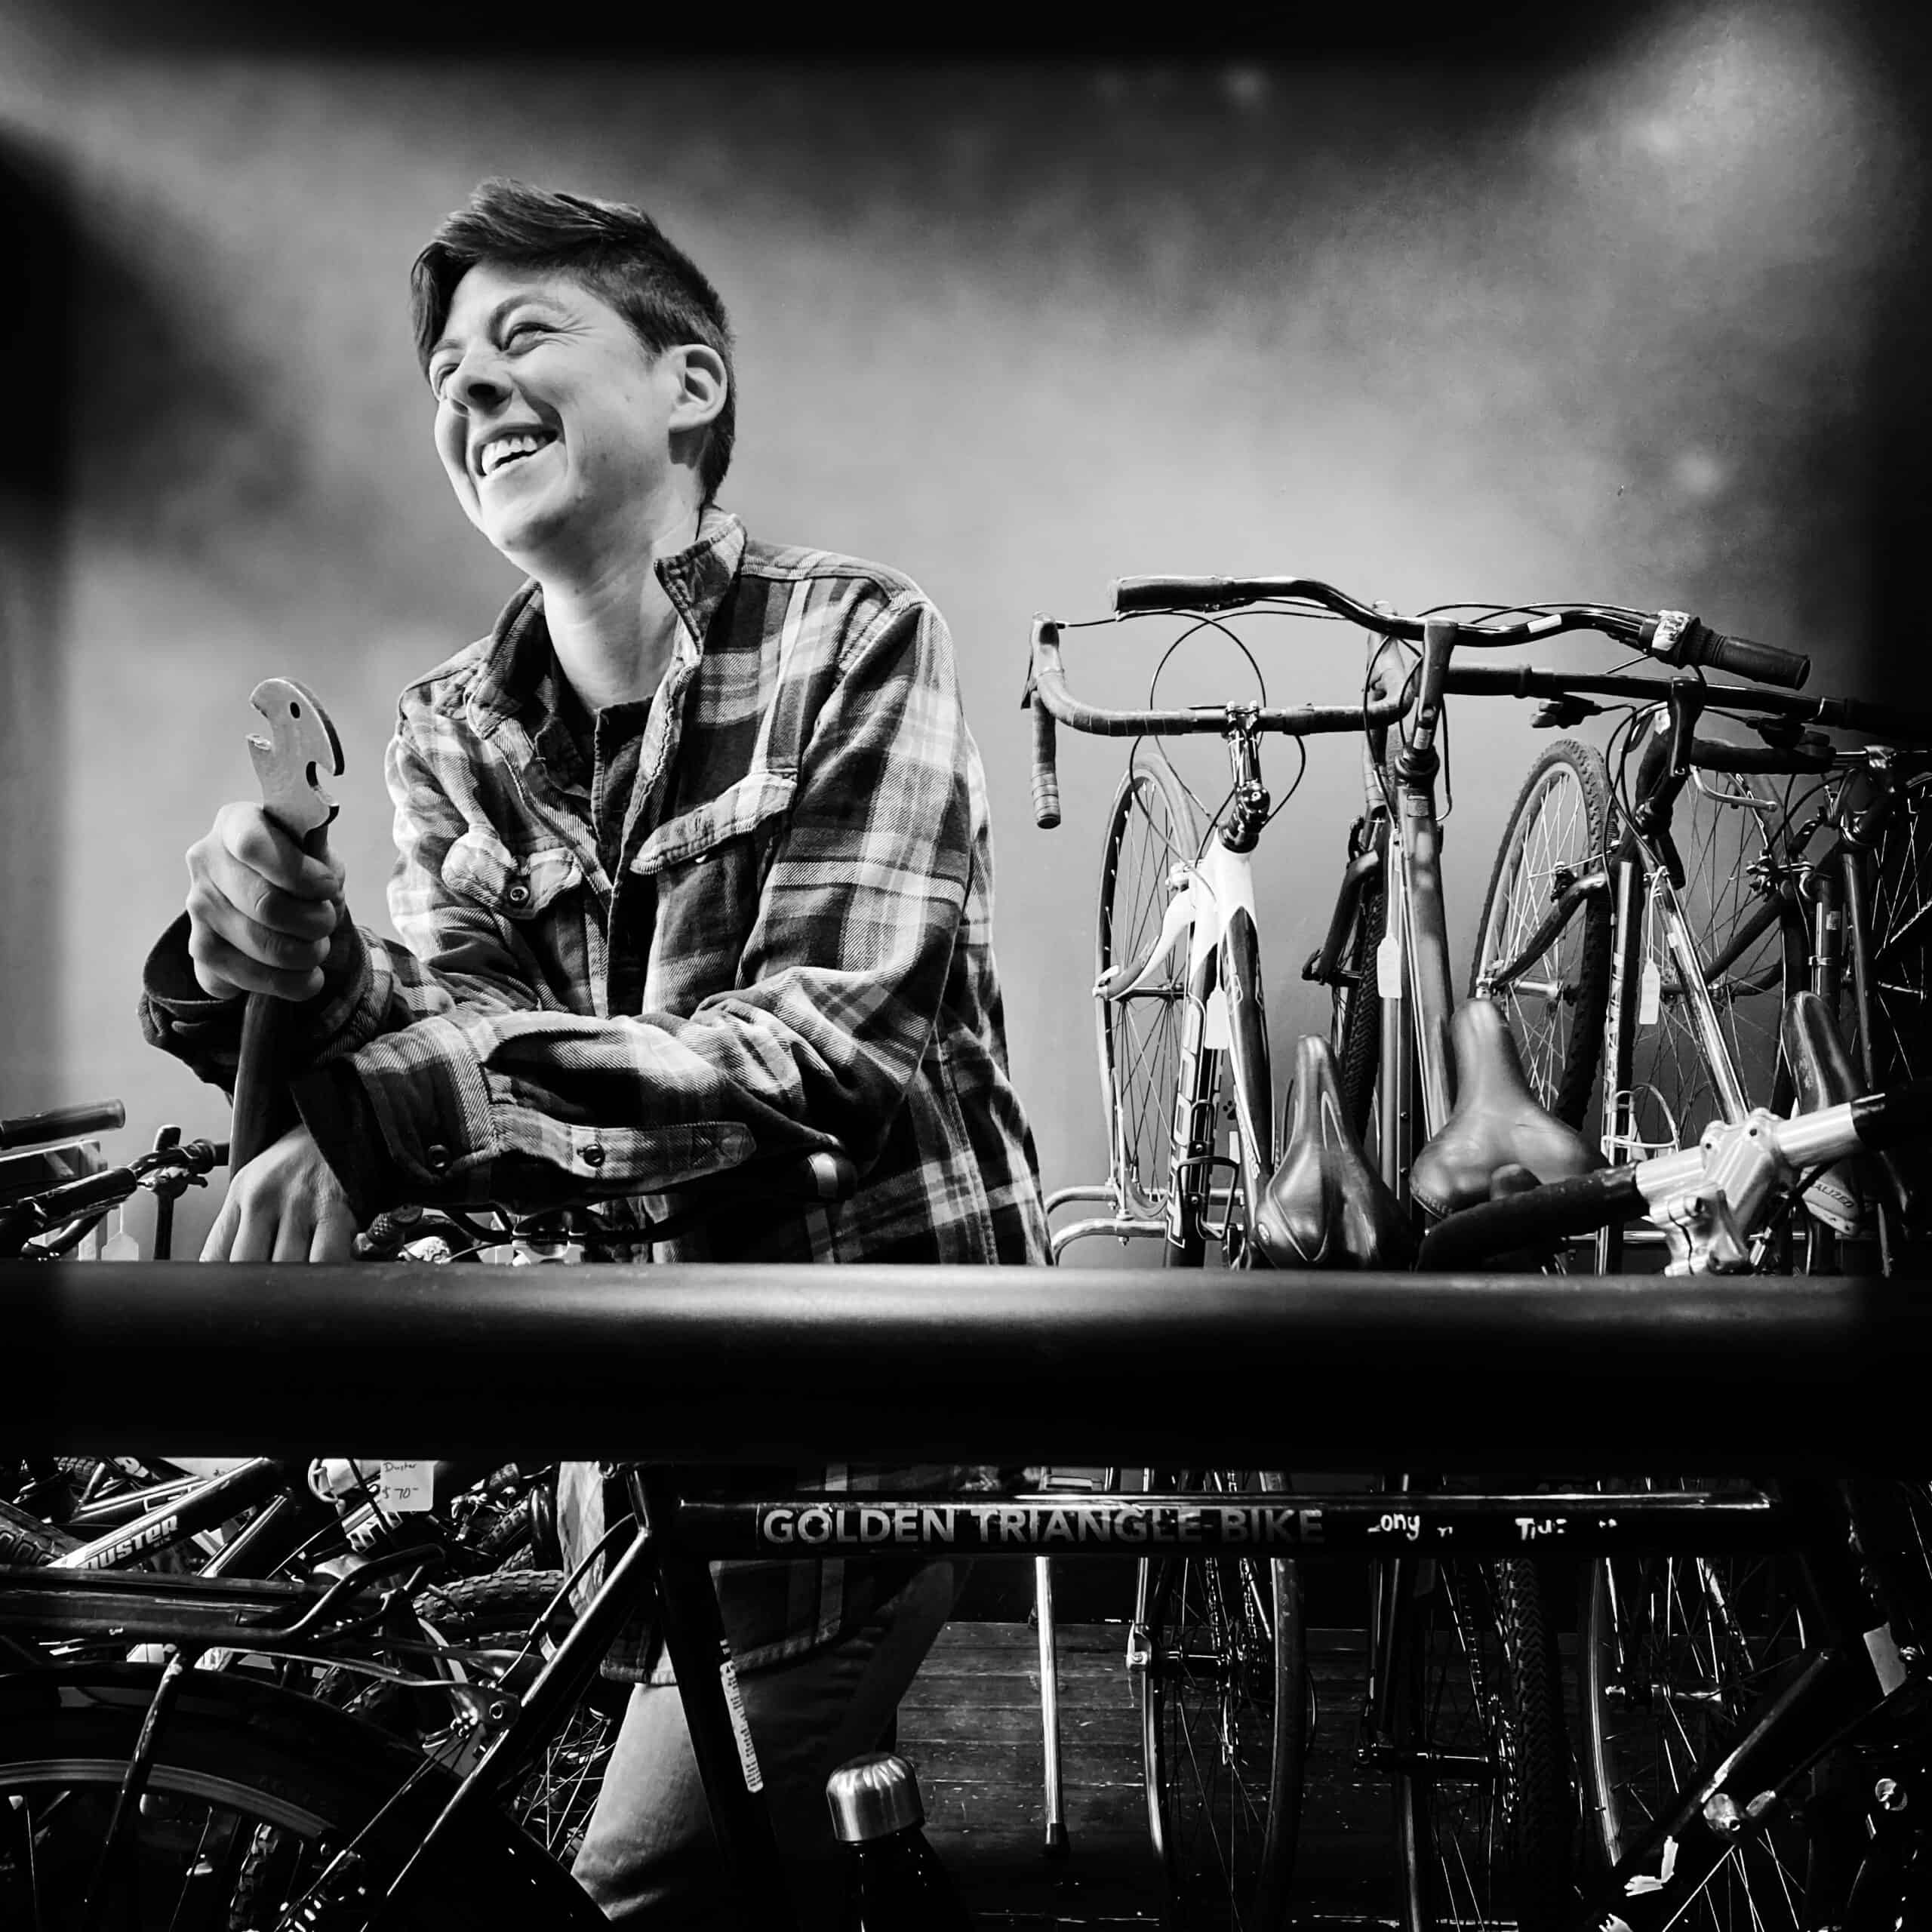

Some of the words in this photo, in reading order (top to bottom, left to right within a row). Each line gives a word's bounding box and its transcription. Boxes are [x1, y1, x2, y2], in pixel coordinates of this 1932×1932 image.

[763, 1508, 955, 1543] GOLDEN
[971, 1508, 1202, 1543] TRIANGLE
[1220, 1508, 1323, 1543] BIKE
